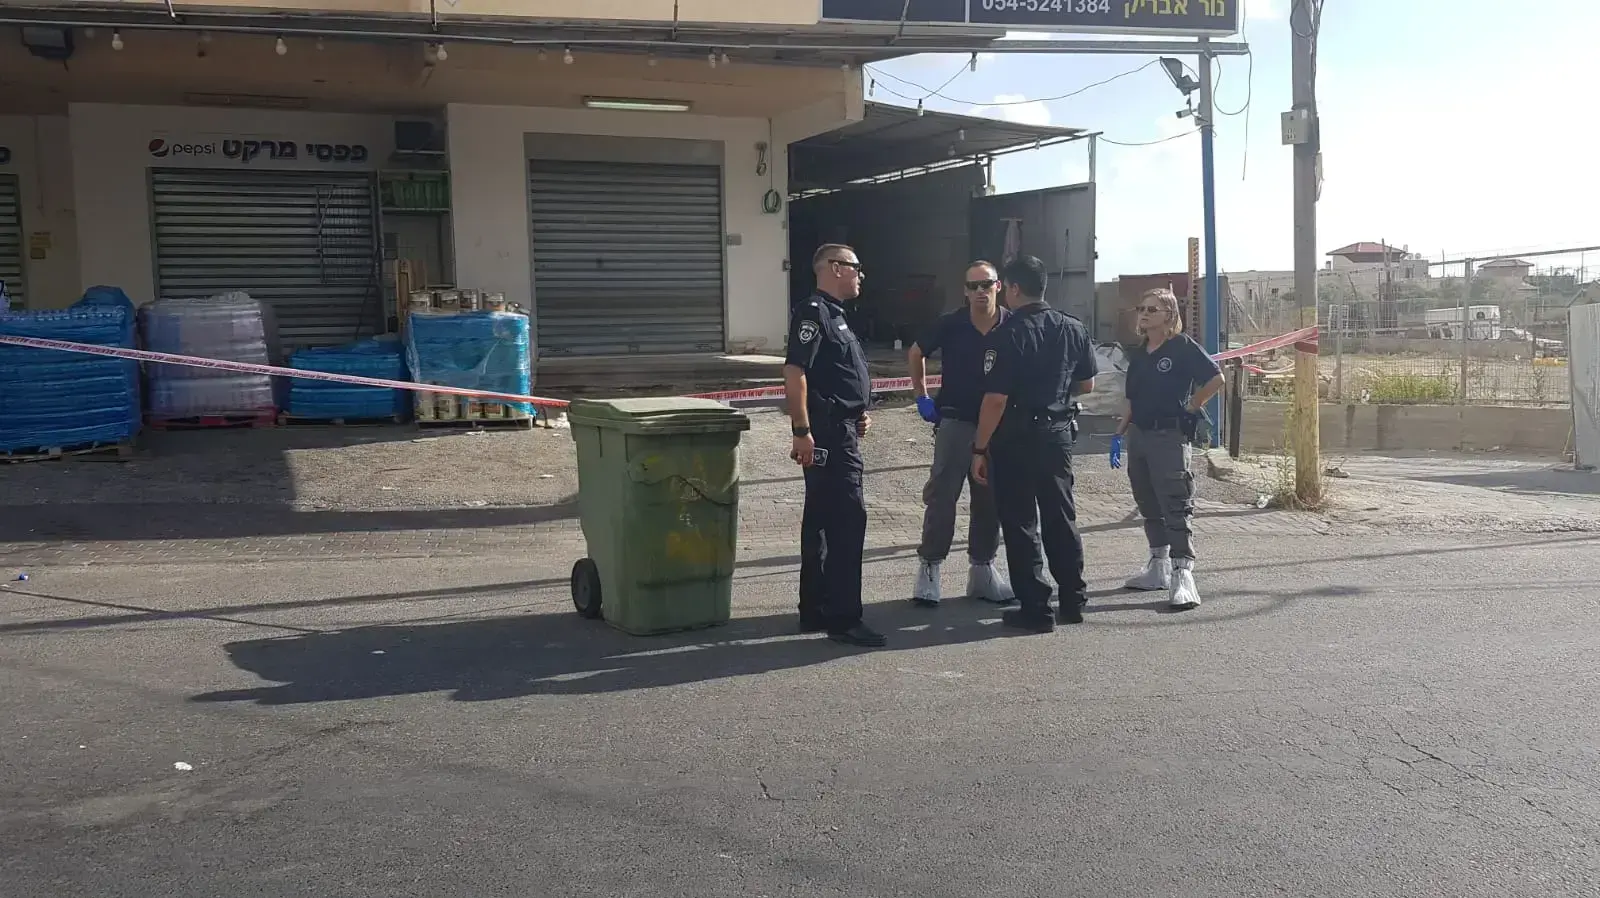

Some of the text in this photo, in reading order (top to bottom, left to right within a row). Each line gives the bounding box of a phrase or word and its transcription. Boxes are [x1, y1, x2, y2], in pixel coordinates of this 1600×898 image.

[982, 0, 1111, 13] 054-5241384
[172, 142, 216, 156] pepsi
[221, 139, 369, 162] פפסי מרקט
